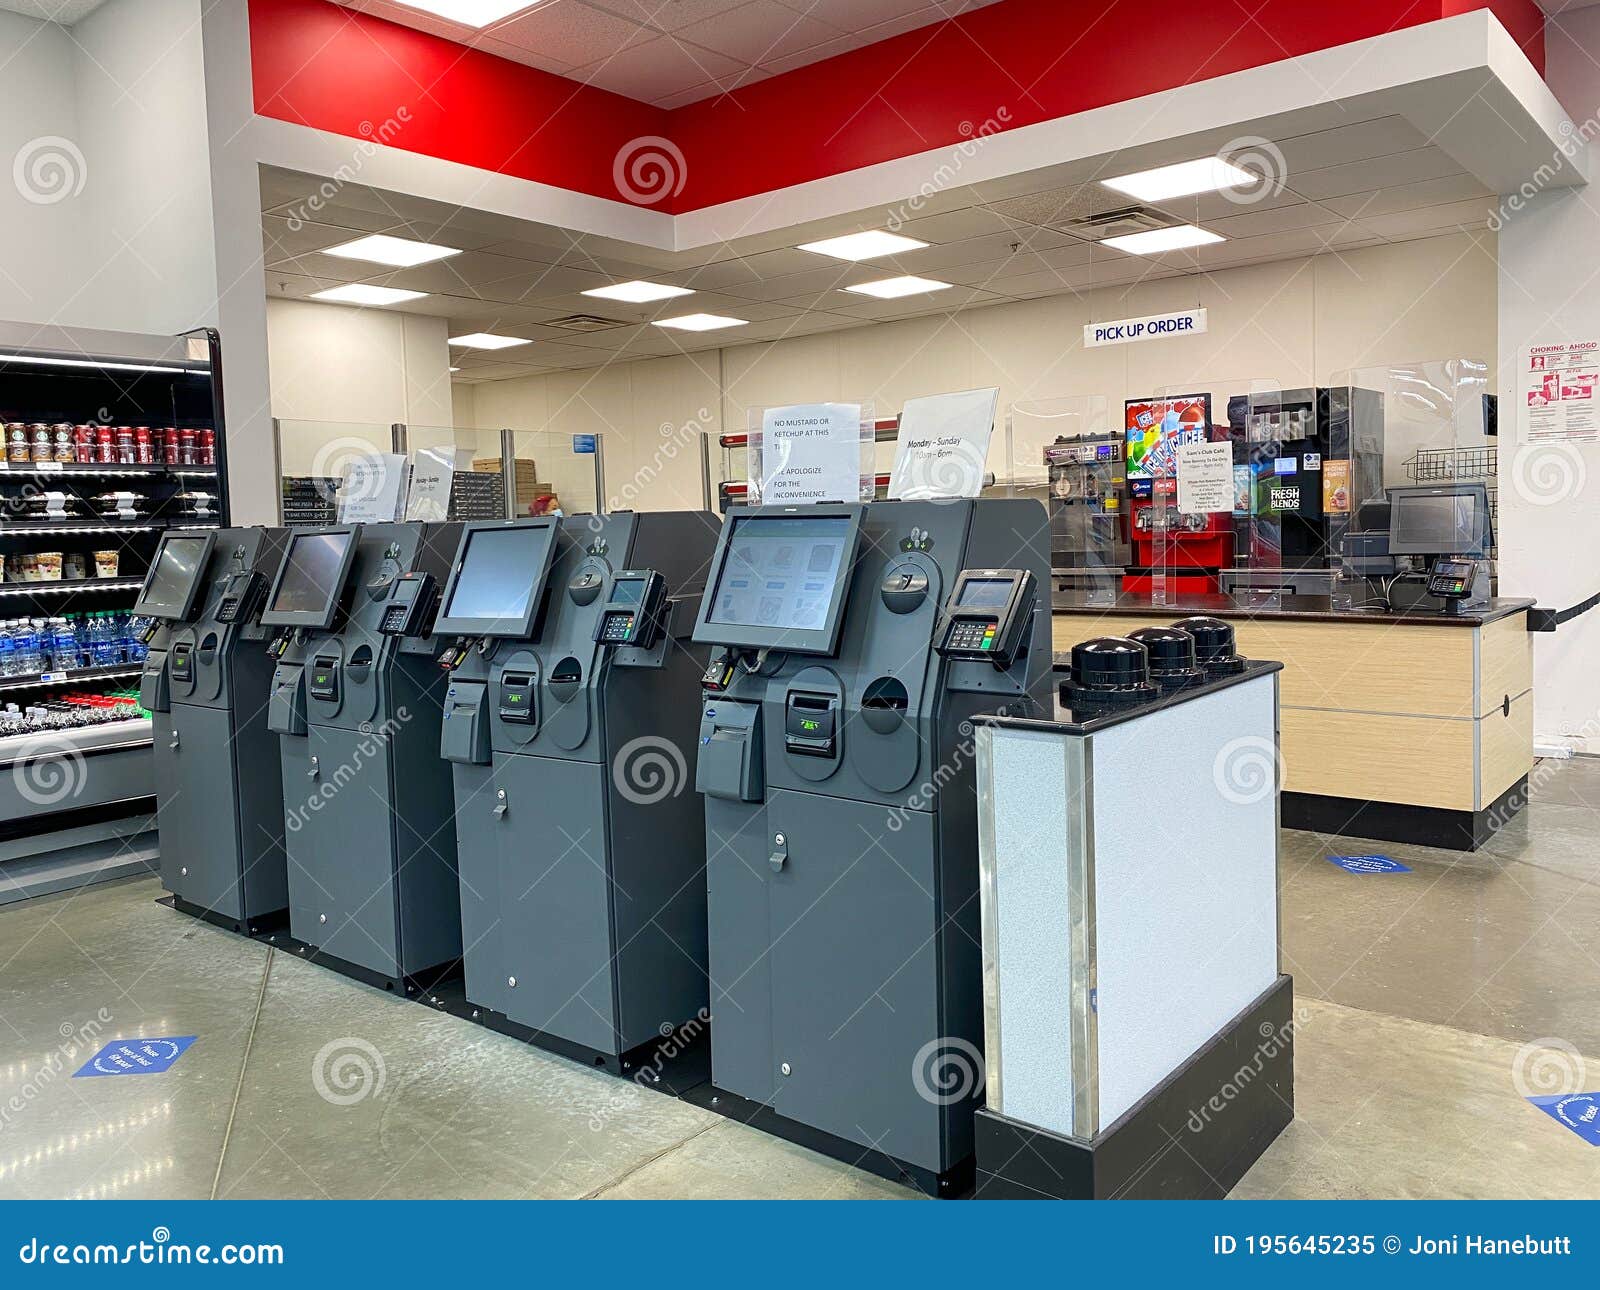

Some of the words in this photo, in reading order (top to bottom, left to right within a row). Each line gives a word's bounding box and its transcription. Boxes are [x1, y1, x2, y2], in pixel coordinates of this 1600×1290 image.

[1095, 326, 1124, 341] PICK
[1126, 323, 1144, 337] UP
[1147, 317, 1193, 334] ORDER
[1530, 345, 1565, 354] CHOKING
[786, 418, 818, 427] MUSTARD
[774, 430, 804, 438] KETCHUP
[907, 439, 932, 448] Monday
[937, 437, 962, 446] Sunday
[786, 467, 822, 475] APOLOGIZE
[788, 480, 801, 488] THE
[773, 490, 826, 499] INCONVENIENCE
[1270, 488, 1300, 499] FRESH
[1270, 499, 1300, 509] BLENDS
